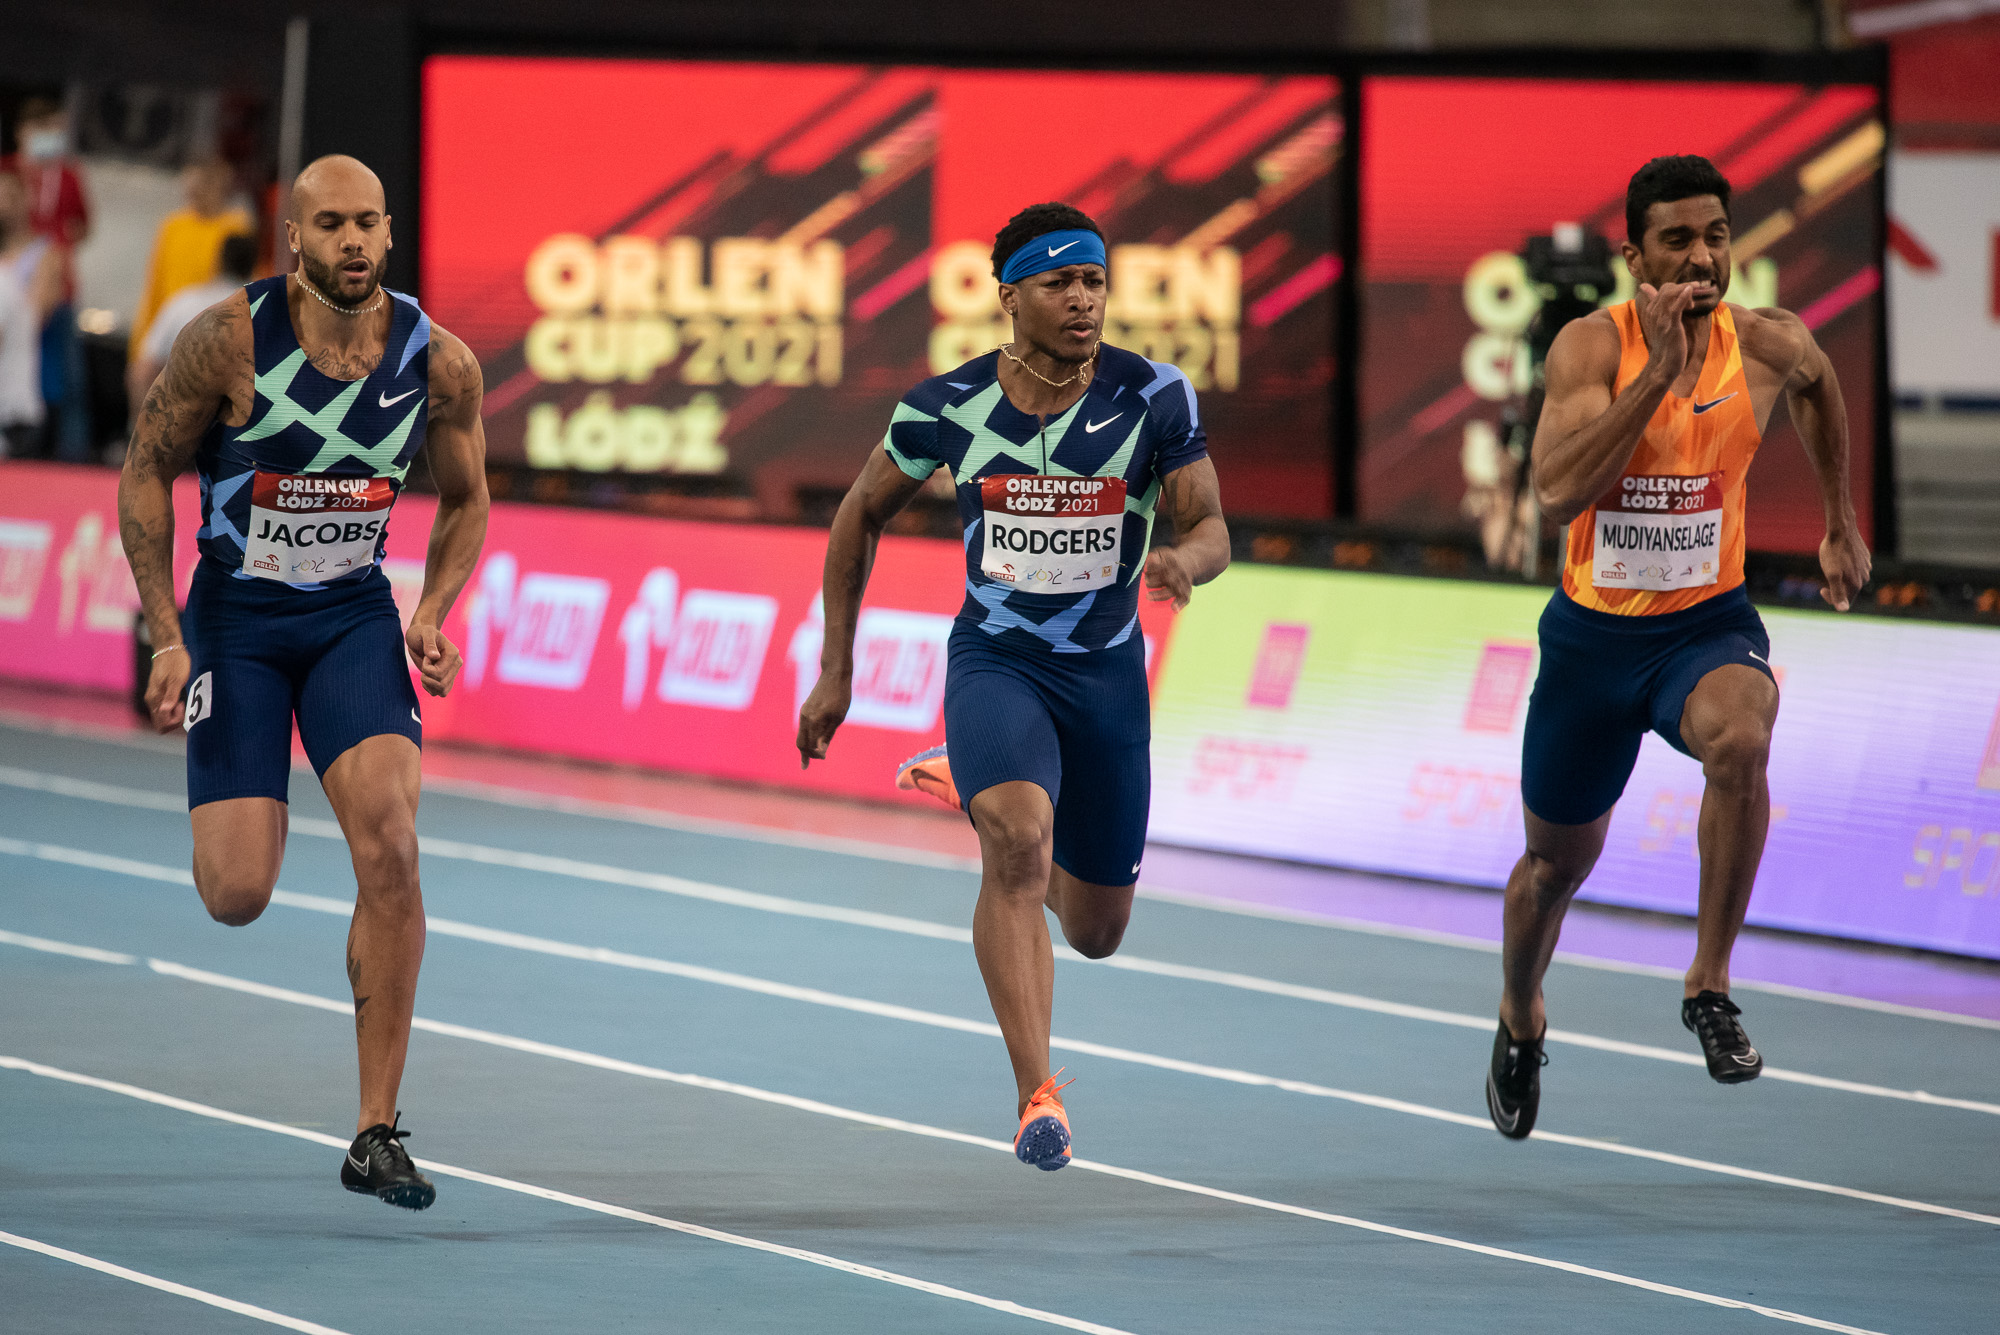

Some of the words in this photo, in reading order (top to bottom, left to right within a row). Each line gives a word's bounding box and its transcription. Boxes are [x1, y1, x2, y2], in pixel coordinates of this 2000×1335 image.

[524, 231, 846, 318] ORLEN
[524, 314, 681, 385] CUP
[680, 318, 845, 388] 2021
[278, 478, 337, 494] ORLEN
[339, 479, 370, 494] CUP
[1006, 478, 1067, 495] ORLEN
[1069, 479, 1104, 495] CUP
[1622, 476, 1681, 492] ORLEN
[1682, 477, 1710, 493] CUP
[276, 493, 327, 509] ŁÓDŹ
[330, 496, 369, 509] 2021
[1006, 494, 1056, 512] ŁÓDŹ
[1061, 498, 1099, 512] 2021
[1621, 492, 1669, 510] ŁÓDŹ
[1674, 494, 1704, 511] 2021
[257, 518, 381, 548] JACOBS
[991, 523, 1117, 555] RODGERS
[1602, 522, 1716, 552] MUDIYANSELAGE
[254, 560, 279, 572] ORLEN
[991, 572, 1015, 582] ORLEN
[1601, 571, 1626, 580] ORLEN
[188, 678, 203, 723] 5
